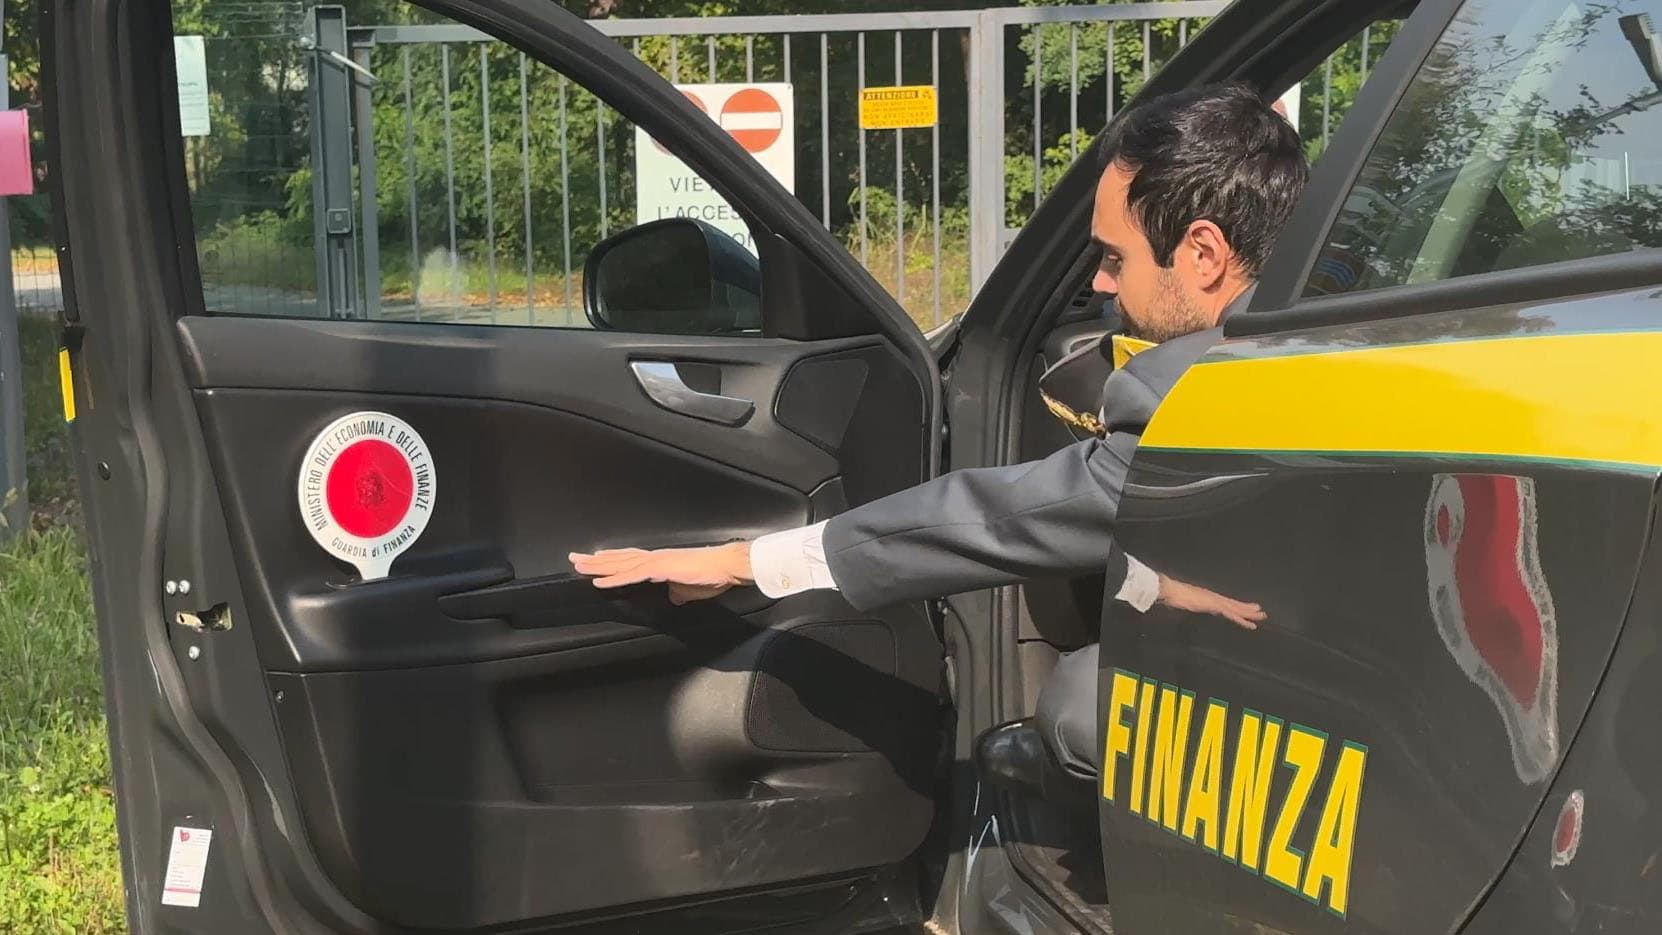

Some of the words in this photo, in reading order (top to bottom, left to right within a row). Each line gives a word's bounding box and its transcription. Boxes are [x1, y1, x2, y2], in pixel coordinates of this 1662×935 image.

[865, 90, 917, 100] ATTENZIONE
[307, 470, 329, 531] MINISTERO
[335, 420, 385, 446] ECONOMIA
[388, 425, 396, 439] E
[395, 431, 423, 461] DELLE
[415, 463, 431, 511] FINANZE
[331, 537, 368, 558] GUARDIA
[371, 546, 381, 558] di
[383, 524, 417, 554] FINANZA
[1101, 667, 1369, 921] FINANZA
